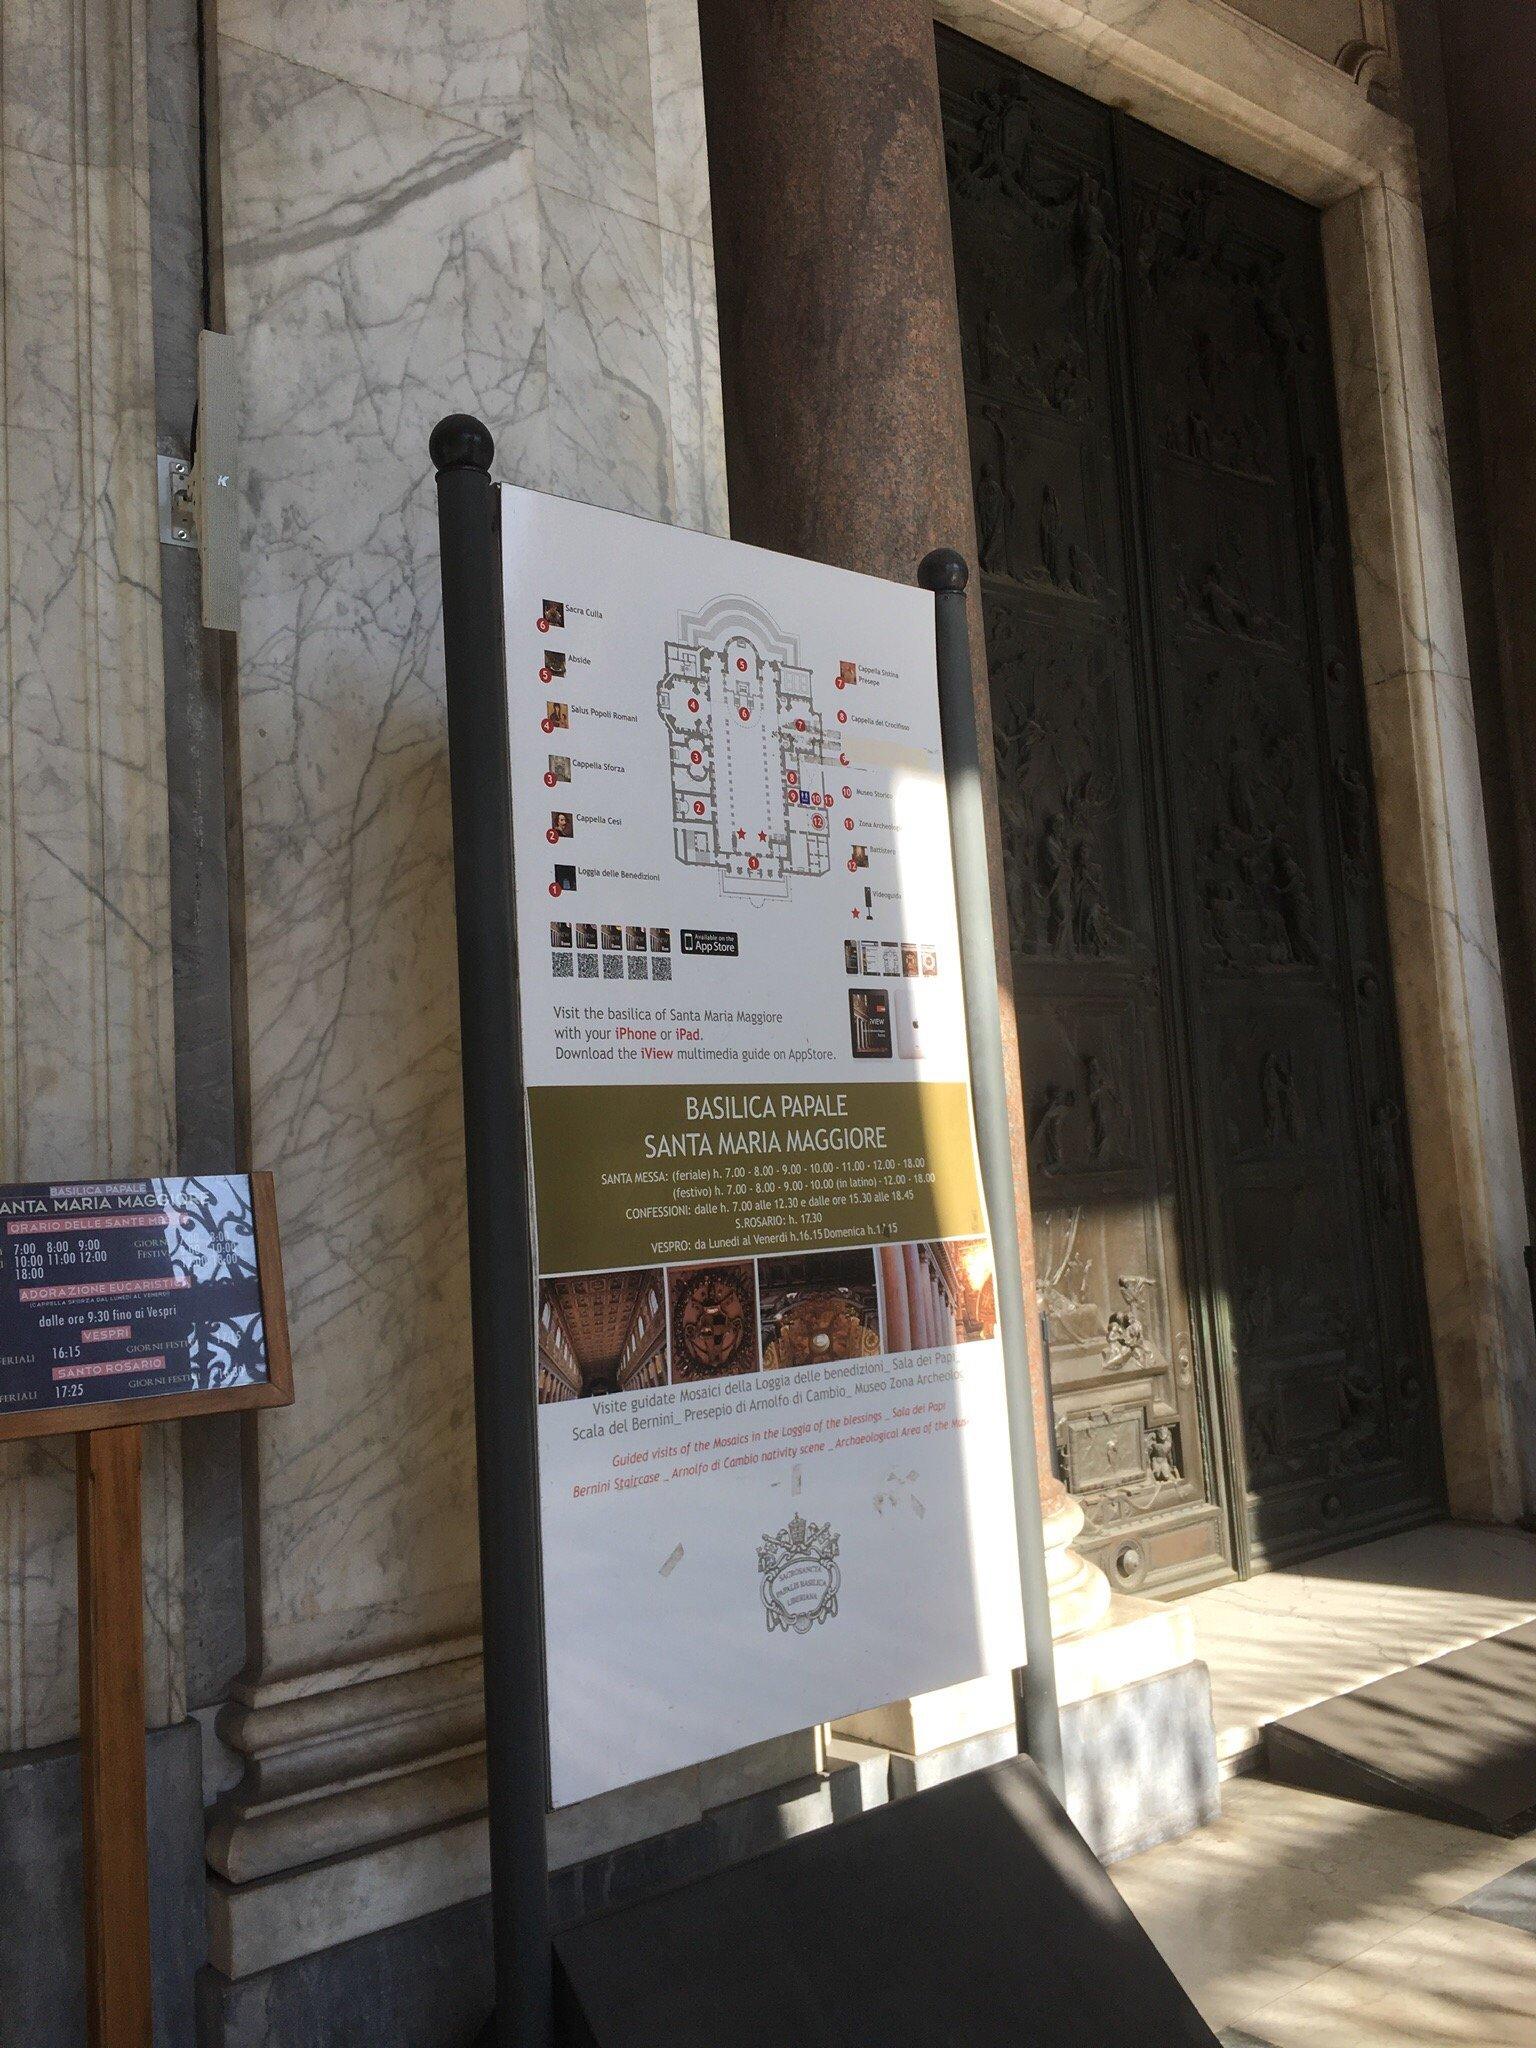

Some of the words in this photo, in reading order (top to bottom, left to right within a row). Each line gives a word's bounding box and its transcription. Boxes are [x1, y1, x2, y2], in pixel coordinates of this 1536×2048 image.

[566, 605, 584, 615] Sacra
[568, 654, 591, 665] Abside
[572, 705, 589, 715] Salus
[590, 709, 611, 719] Popoli
[613, 712, 638, 722] Romani
[572, 759, 602, 770] Cappella
[603, 764, 625, 773] Sforza
[577, 814, 606, 824] Cappella
[608, 817, 621, 825] Cesi
[578, 867, 600, 877] Loggia
[602, 869, 619, 877] delle
[621, 871, 660, 881] Benedizioni
[696, 943, 712, 952] App
[713, 943, 735, 952] Store
[554, 1007, 580, 1019] Visit
[585, 1007, 604, 1019] the
[608, 1008, 651, 1020] basilica
[655, 1009, 667, 1021] of
[671, 1010, 701, 1021] Santa
[704, 1011, 733, 1021] Maria
[737, 1011, 782, 1025] Maggiore
[555, 1027, 581, 1039] with
[585, 1029, 611, 1042] your
[616, 1027, 657, 1039] iPhone
[660, 1030, 672, 1040] or
[676, 1029, 703, 1040] iPad.
[556, 1047, 613, 1059] Download
[619, 1048, 637, 1059] the
[641, 1048, 673, 1059] iView
[678, 1048, 738, 1059] multimedia
[743, 1049, 770, 1062] guide
[774, 1051, 786, 1059] on
[789, 1049, 836, 1062] AppStore.
[686, 1096, 776, 1120] BASILICA
[782, 1095, 848, 1117] PAPALE
[645, 1133, 713, 1158] SANTA
[718, 1130, 782, 1155] MARIA
[786, 1127, 887, 1152] MAGGIORE
[601, 1172, 632, 1185] SANTA
[635, 1171, 668, 1183] MESSA:
[672, 1169, 710, 1182] (feriale)
[725, 1167, 745, 1178] 7.00
[754, 1165, 773, 1176] 8.00
[782, 1164, 801, 1174] 9.00
[811, 1162, 833, 1173] 10.00
[842, 1161, 864, 1172] 11.00
[873, 1159, 895, 1170] 12.00
[903, 1158, 925, 1168] 18.00
[50, 1187, 102, 1197] BASILICA
[105, 1184, 146, 1193] PAPALE
[673, 1187, 712, 1200] (festivo)
[727, 1184, 746, 1195] 7.00
[756, 1183, 775, 1193] 8.00
[784, 1181, 802, 1191] 9.00
[811, 1180, 833, 1190] 10.00
[836, 1178, 847, 1191] (in
[850, 1177, 877, 1188] latino)
[884, 1175, 905, 1185] 12.00
[914, 1173, 935, 1183] 18.00
[0, 1200, 47, 1214] ANTA
[54, 1197, 111, 1211] MARIA
[626, 1206, 691, 1219] CONFESSIONI:
[695, 1203, 717, 1215] dalle
[733, 1201, 752, 1212] 7.00
[755, 1200, 771, 1210] alle
[775, 1198, 798, 1209] 12.30
[809, 1196, 830, 1207] dalle
[832, 1197, 846, 1205] ore
[850, 1193, 872, 1203] 15.30
[874, 1192, 889, 1202] alle
[892, 1190, 914, 1200] 18.45
[11, 1222, 60, 1233] ORARIO
[65, 1220, 101, 1230] DELLE
[105, 1218, 144, 1227] SANTE
[735, 1215, 786, 1229] S.ROSARIO:
[801, 1213, 822, 1223] 17.30
[14, 1243, 35, 1255] 7:00
[47, 1241, 68, 1253] 8:00
[79, 1239, 100, 1250] 9:00
[134, 1239, 167, 1247] GIORN
[651, 1241, 691, 1253] VESPRO:
[695, 1239, 706, 1250] da
[824, 1227, 865, 1238] Domenica
[15, 1255, 43, 1267] 10:00
[48, 1253, 76, 1265] 11:00
[80, 1251, 107, 1263] 12:00
[138, 1250, 169, 1259] FESTIV
[16, 1268, 44, 1280] 18:00
[20, 1286, 106, 1300] ADORAZIONE
[39, 1315, 64, 1327] dalle
[68, 1316, 84, 1324] ore
[88, 1310, 109, 1322] 9:30
[113, 1310, 131, 1320] fino
[135, 1308, 144, 1318] ai
[147, 1305, 176, 1319] Vespri
[82, 1329, 129, 1340] VESPRI
[53, 1346, 80, 1359] 16:15
[126, 1343, 162, 1353] GIORNI
[58, 1366, 101, 1378] SANTO
[105, 1358, 161, 1373] ROSARIO
[56, 1384, 83, 1398] 17:25
[129, 1378, 165, 1388] GIORNI
[593, 1401, 627, 1415] Visite
[631, 1393, 675, 1412] guidate
[680, 1388, 721, 1402] Mosaici
[725, 1381, 751, 1394] della
[756, 1375, 790, 1393] Loggia
[794, 1368, 820, 1383] delle
[893, 1358, 914, 1371] Sala
[917, 1356, 932, 1367] dei
[573, 1424, 604, 1441] Scala
[609, 1421, 628, 1435] del
[685, 1404, 732, 1422] Presepio
[736, 1402, 746, 1413] di
[750, 1395, 789, 1412] Arnolfo
[793, 1393, 802, 1404] di
[855, 1382, 886, 1394] Museo
[890, 1377, 914, 1389] Zona
[612, 1452, 649, 1467] Guided
[651, 1445, 677, 1459] visits
[680, 1444, 691, 1455] of
[694, 1440, 710, 1452] the
[713, 1433, 749, 1450] Mosaics
[764, 1428, 778, 1440] the
[782, 1422, 811, 1437] Loggia
[814, 1420, 823, 1432] of
[827, 1417, 841, 1429] the
[843, 1410, 882, 1426] blessings
[892, 1405, 910, 1418] Sala
[573, 1480, 610, 1498] Bernini
[615, 1472, 660, 1490] Staircase
[672, 1463, 708, 1479] Arnolfo
[724, 1453, 759, 1469] Cambio
[761, 1445, 797, 1462] nativity
[800, 1443, 825, 1455] scene
[835, 1429, 899, 1448] Archaeological
[901, 1424, 921, 1437] Area
